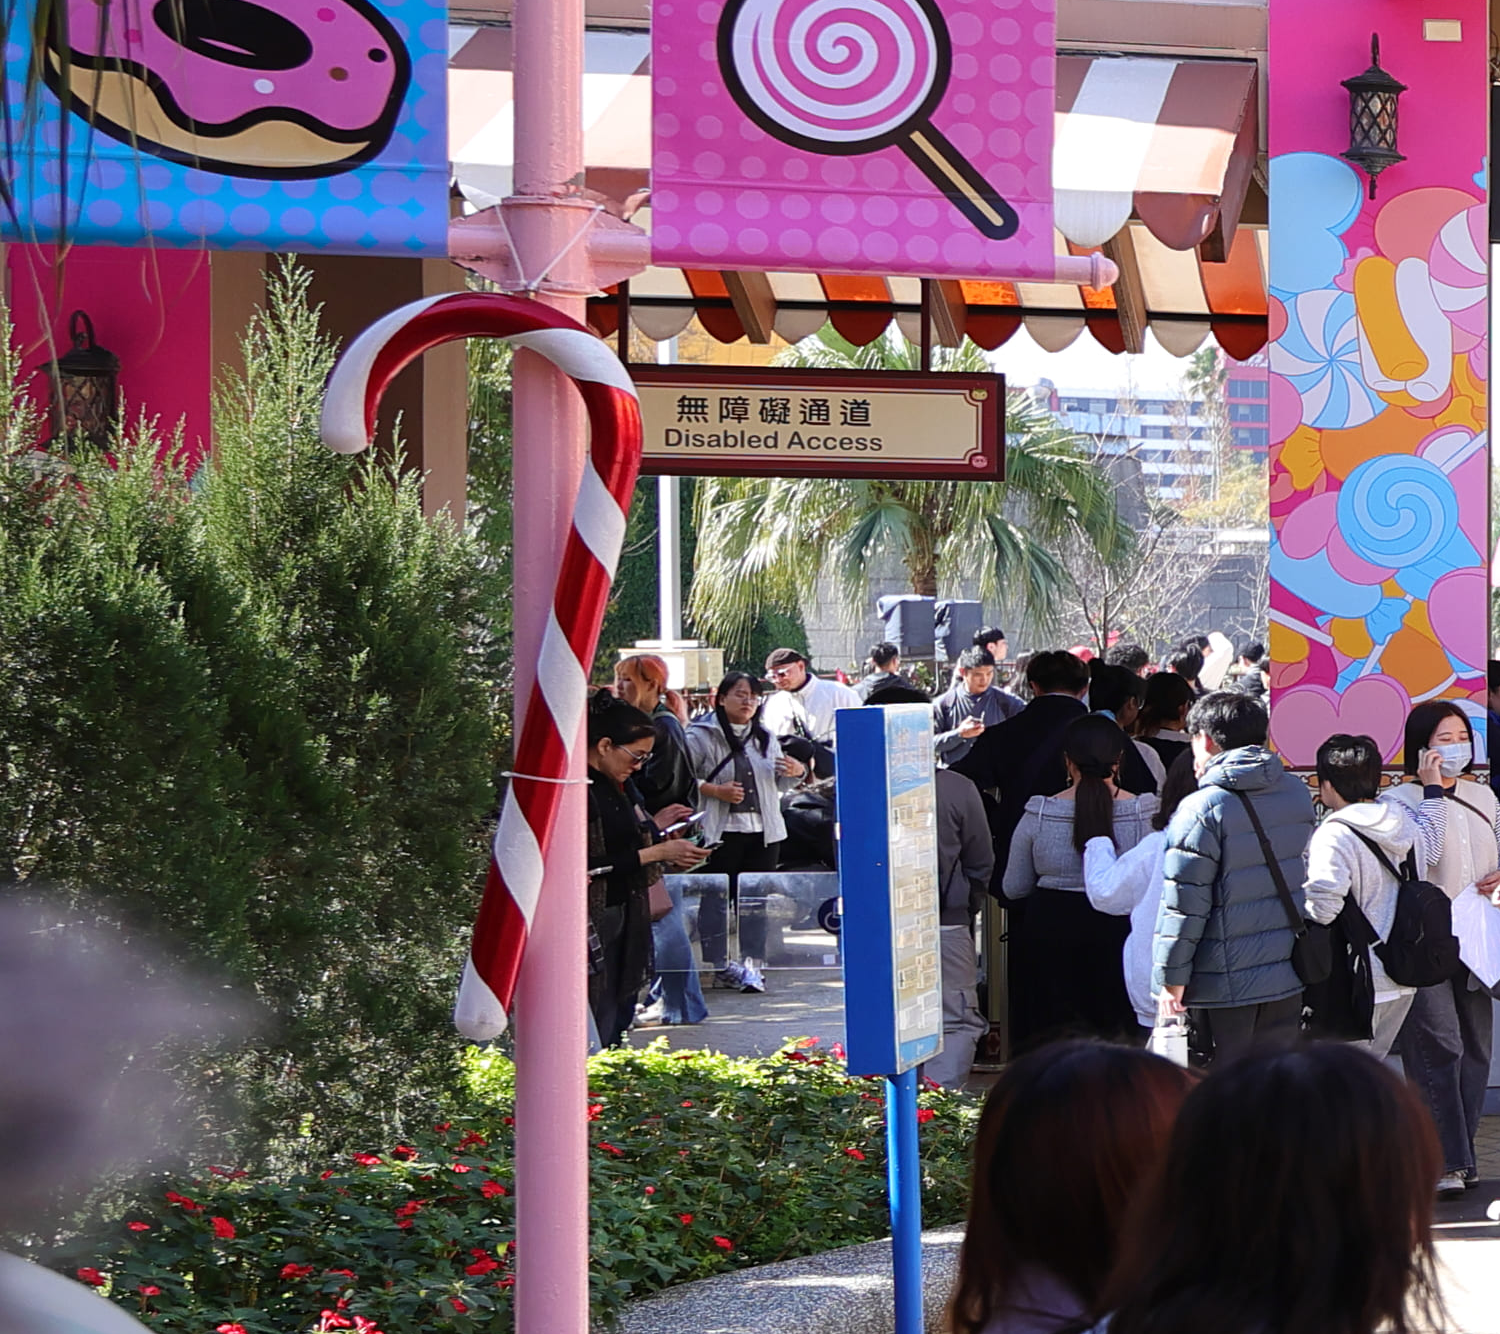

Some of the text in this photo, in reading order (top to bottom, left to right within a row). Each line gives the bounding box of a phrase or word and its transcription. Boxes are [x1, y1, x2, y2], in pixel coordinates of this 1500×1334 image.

[676, 394, 872, 428] 無障礙通道
[664, 428, 883, 452] Disabled Access
